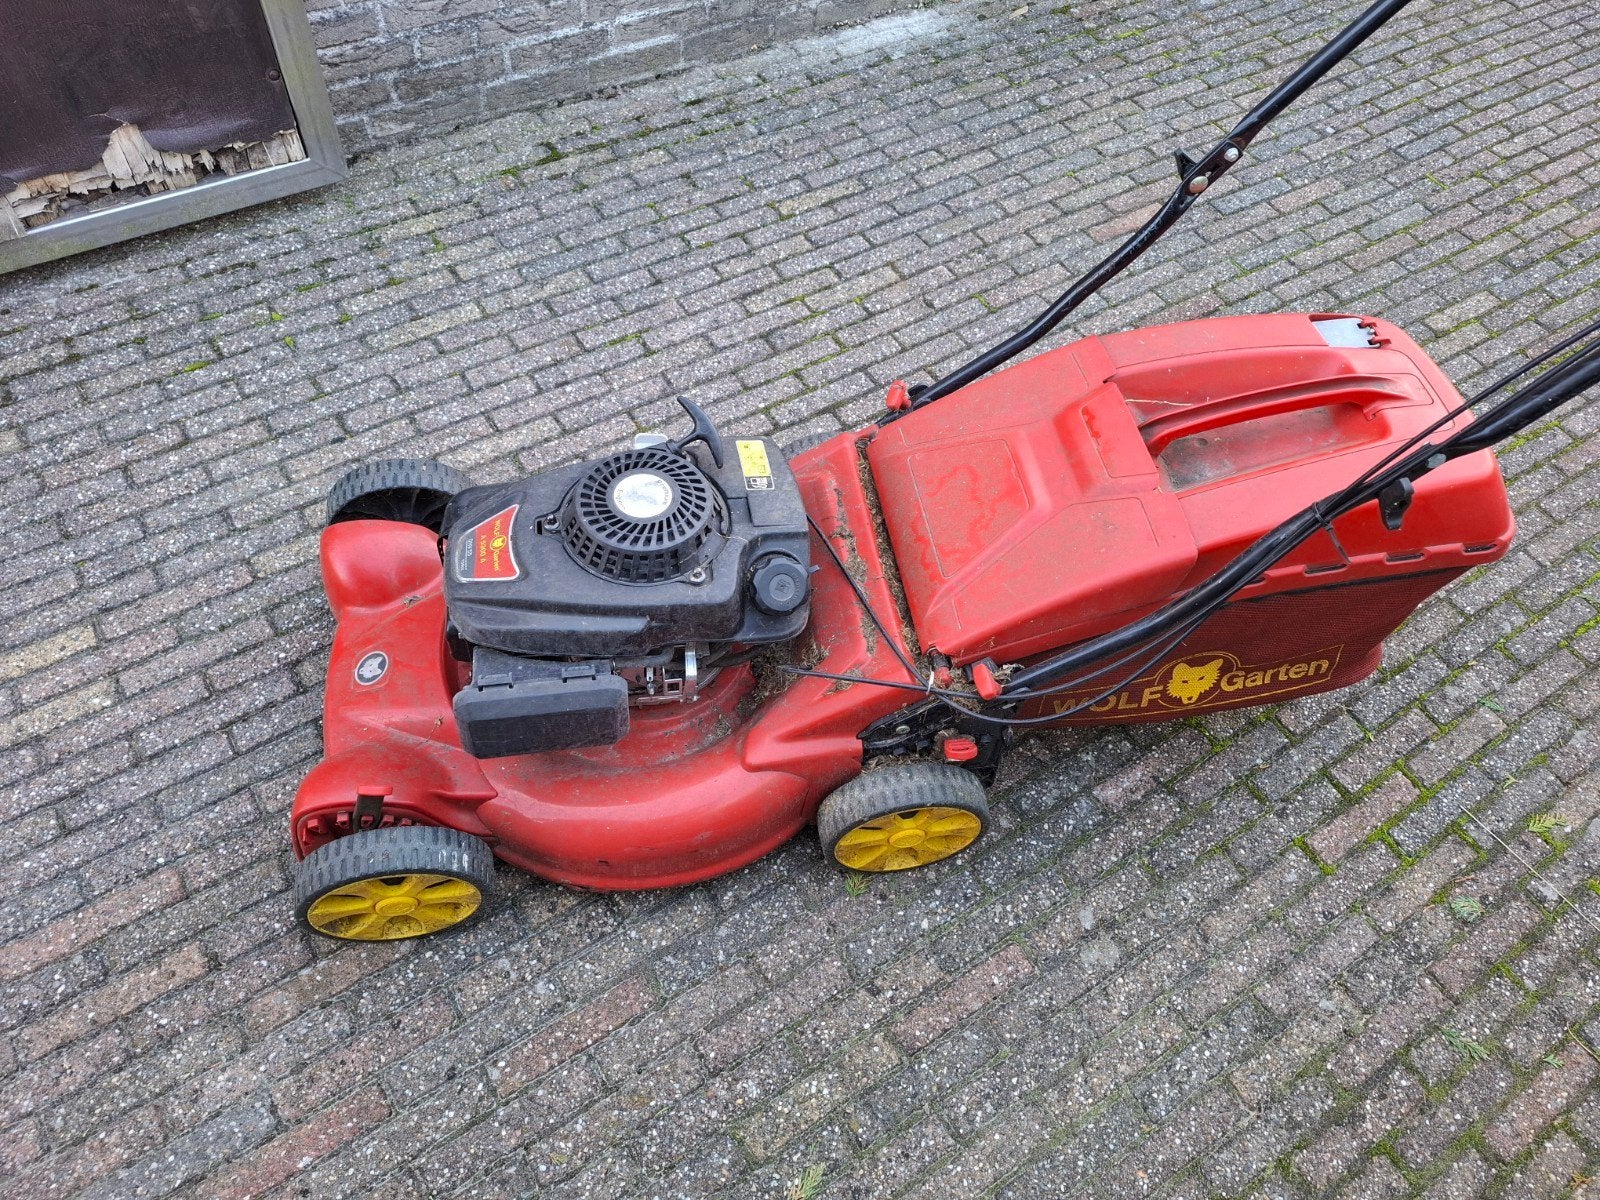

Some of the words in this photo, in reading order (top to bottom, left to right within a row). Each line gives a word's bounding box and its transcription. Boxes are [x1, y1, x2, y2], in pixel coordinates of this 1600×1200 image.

[493, 550, 502, 571] Garten
[1053, 685, 1163, 714] WOLF
[1220, 659, 1330, 692] Garten
